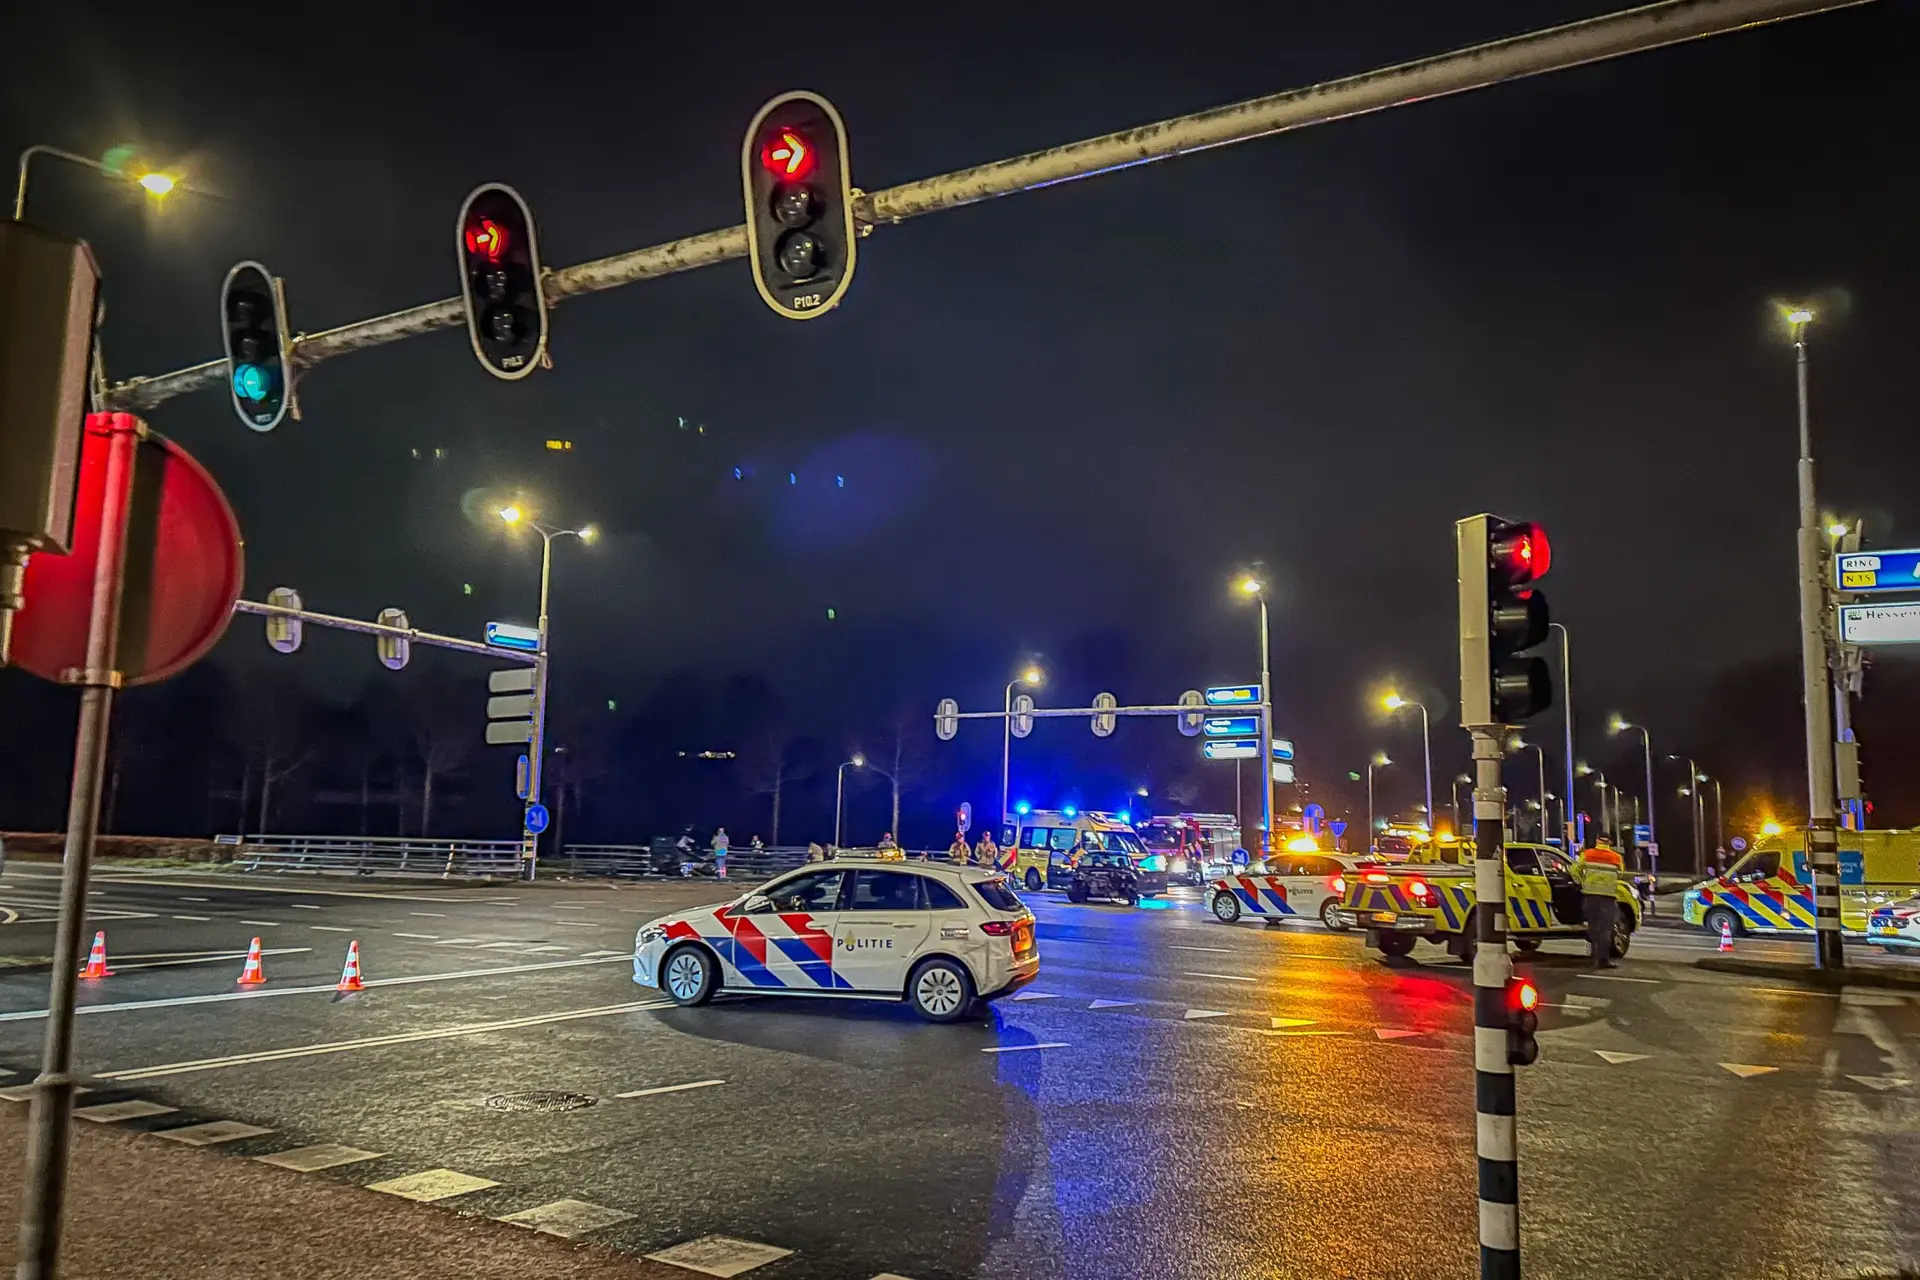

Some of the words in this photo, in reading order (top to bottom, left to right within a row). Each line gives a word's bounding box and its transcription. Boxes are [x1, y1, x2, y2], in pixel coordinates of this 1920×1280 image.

[793, 294, 820, 309] P10.2
[1866, 609, 1920, 619] Hessen
[837, 937, 893, 952] POLITIE
